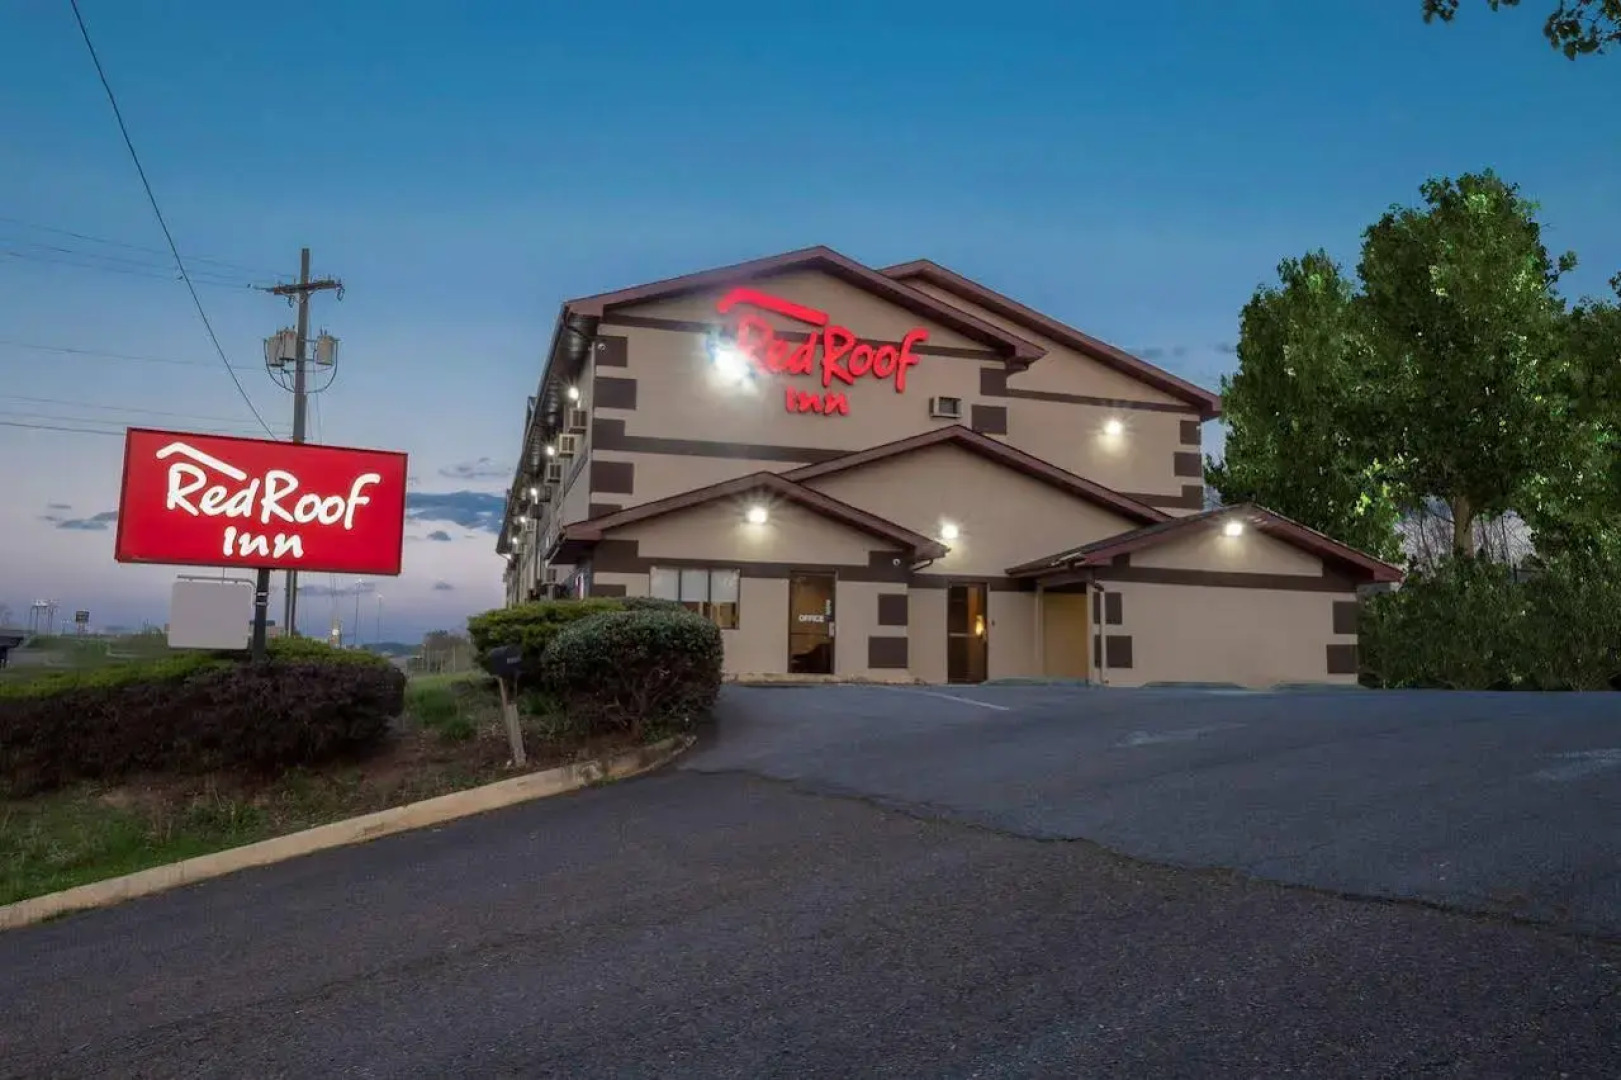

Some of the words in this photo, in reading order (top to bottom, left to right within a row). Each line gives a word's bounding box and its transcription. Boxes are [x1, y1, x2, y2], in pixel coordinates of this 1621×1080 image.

[738, 315, 818, 375] Red
[822, 325, 929, 393] Roof
[786, 386, 849, 416] Inn
[167, 462, 260, 517] Red
[261, 470, 381, 530] Roof
[223, 525, 304, 558] Inn
[799, 614, 824, 622] OFFICE
